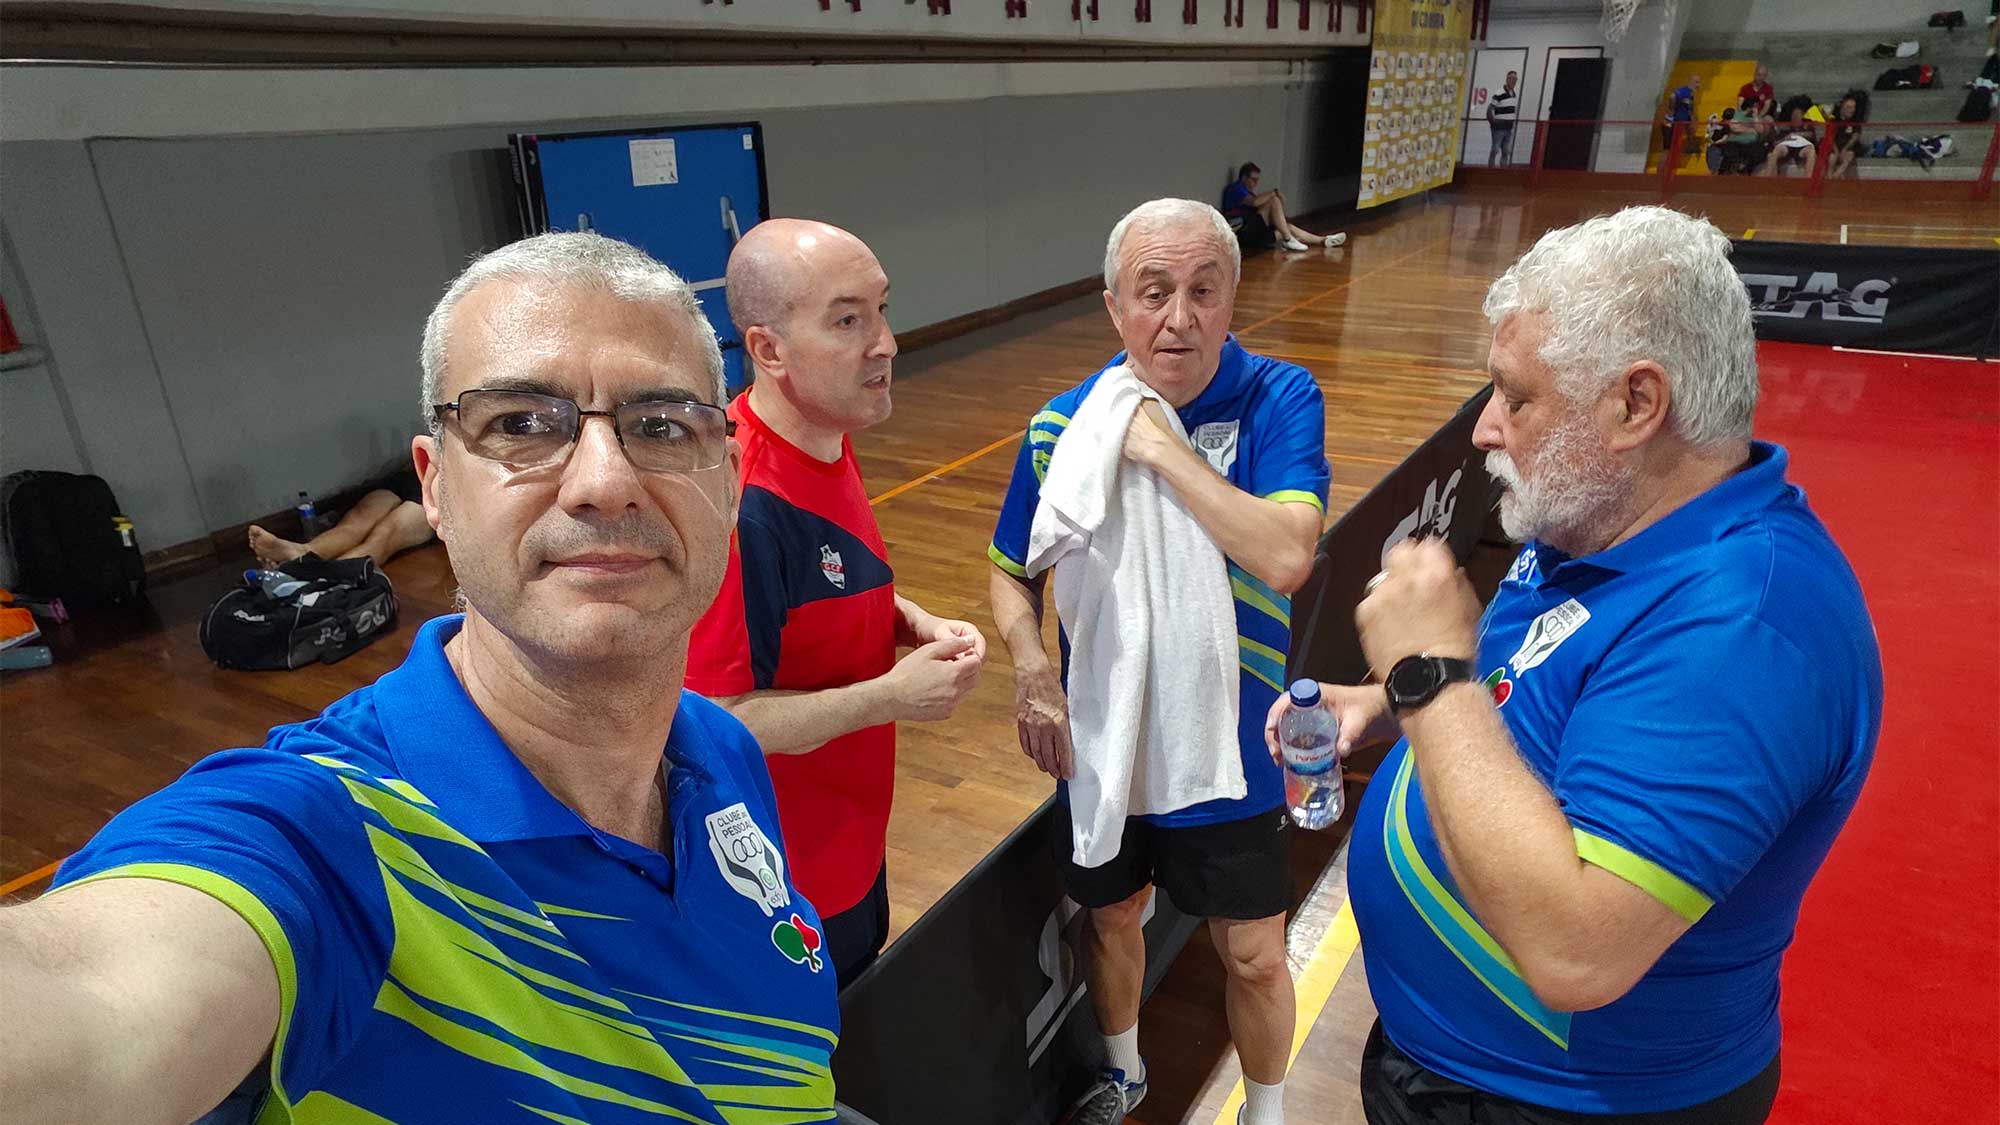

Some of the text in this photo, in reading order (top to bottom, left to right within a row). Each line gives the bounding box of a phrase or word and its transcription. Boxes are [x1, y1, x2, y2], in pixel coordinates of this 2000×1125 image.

[1473, 87, 1488, 106] 19
[1740, 271, 1889, 324] TAG
[717, 810, 741, 827] CLUBE
[722, 821, 754, 838] PESSOAL
